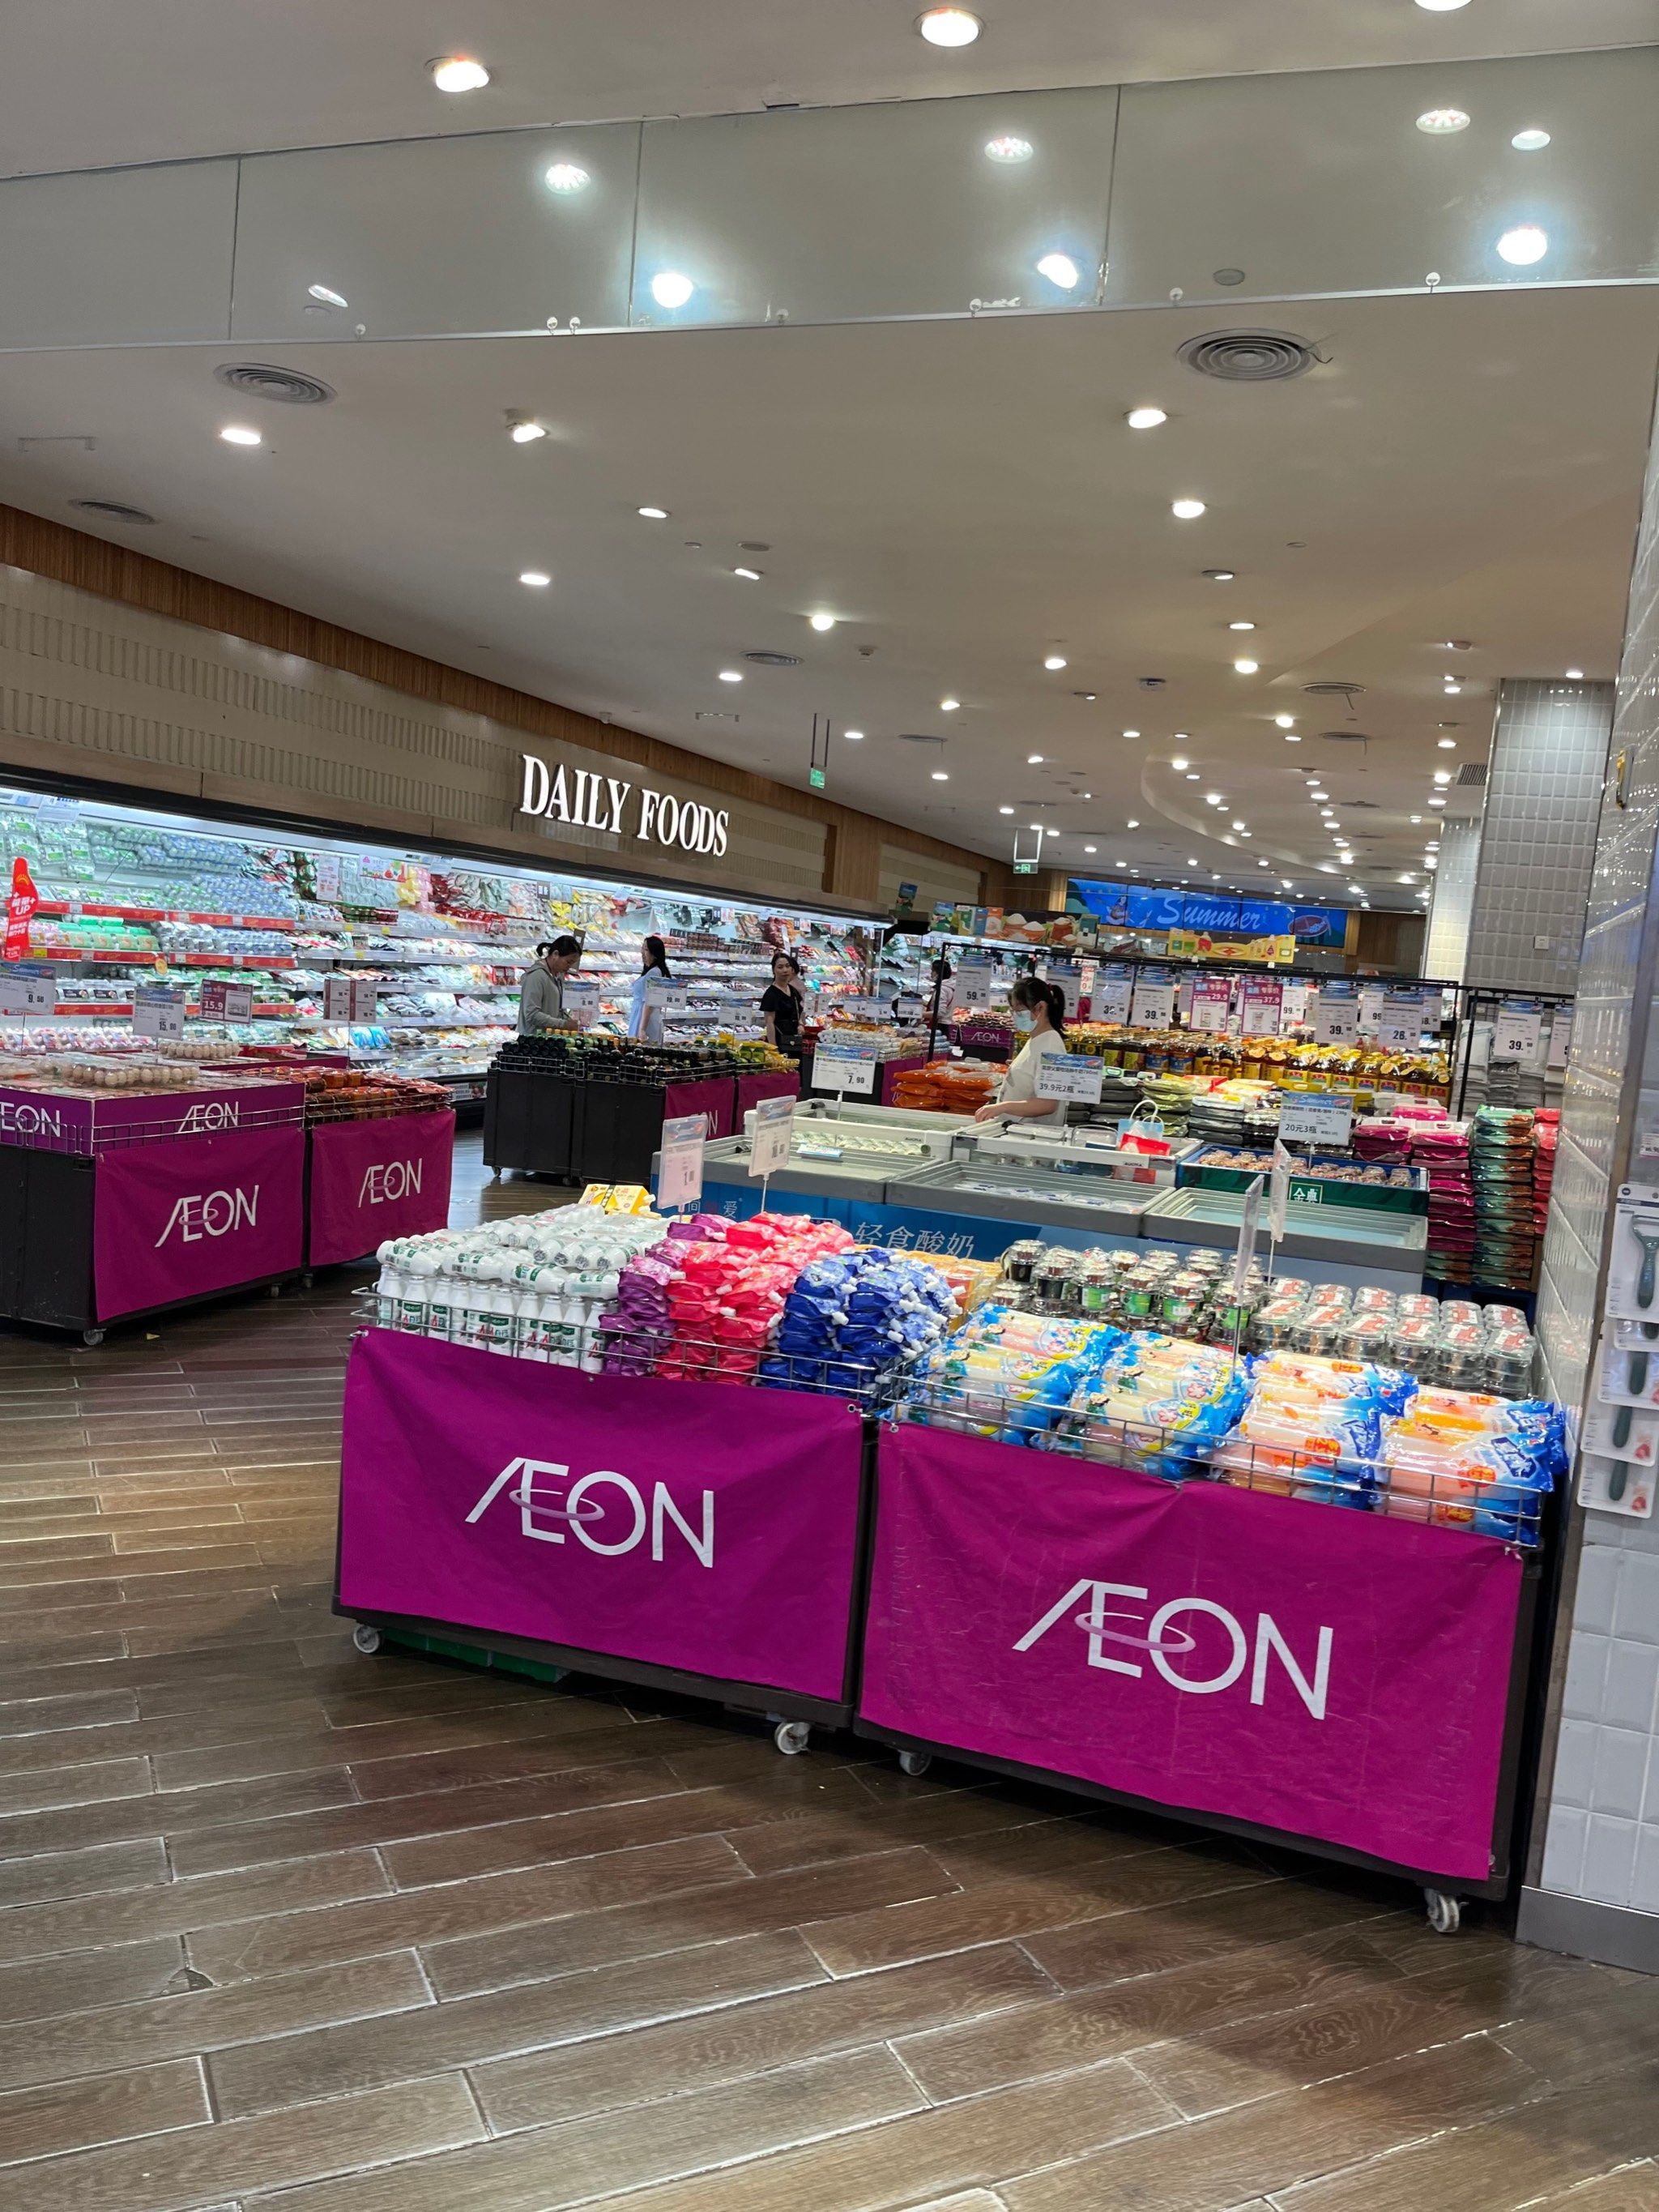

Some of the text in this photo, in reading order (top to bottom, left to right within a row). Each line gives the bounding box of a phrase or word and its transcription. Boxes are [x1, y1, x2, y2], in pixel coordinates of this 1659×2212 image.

[519, 754, 729, 857] DAILY FOODS
[16, 904, 31, 915] UP
[1157, 897, 1262, 930] Summer
[1211, 993, 1228, 1001] 29.9
[1263, 996, 1280, 1004] 37.9
[204, 1000, 224, 1010] 15.9
[1039, 1083, 1075, 1094] 39.9元2瓶
[1285, 1123, 1317, 1134] 20元3瓶
[1292, 1187, 1319, 1204] 金典
[854, 1222, 975, 1259] 轻食酸奶
